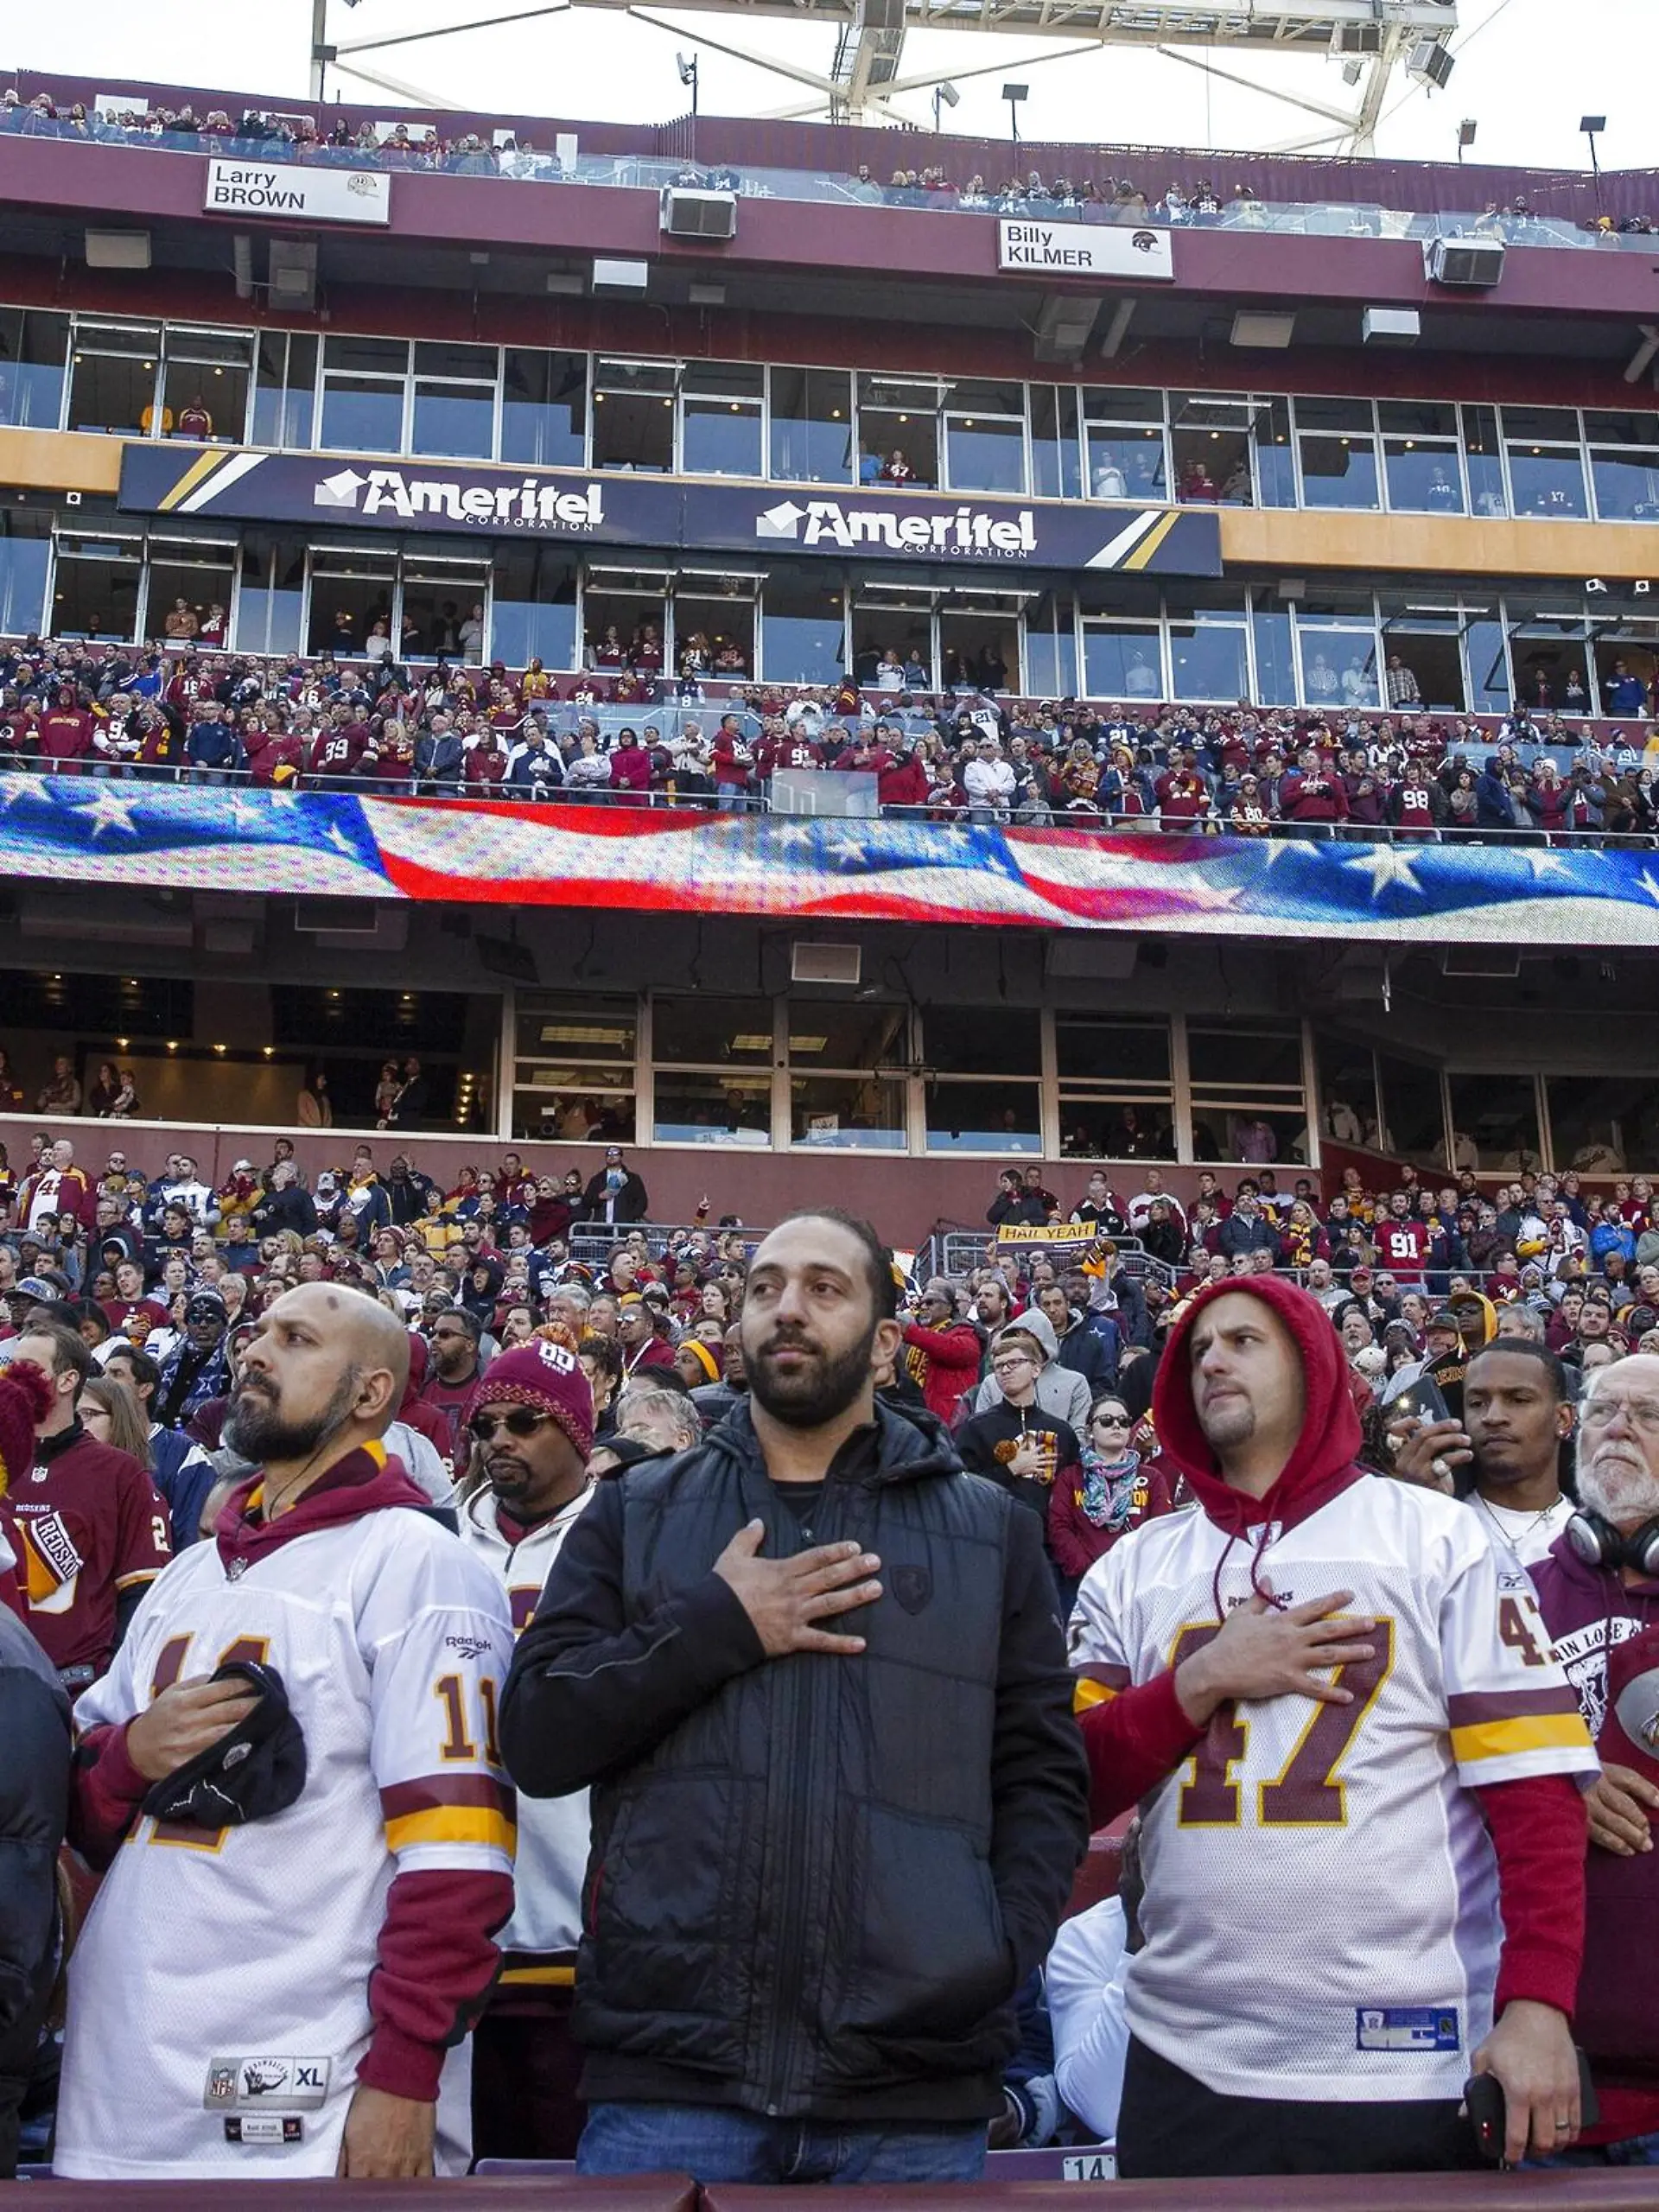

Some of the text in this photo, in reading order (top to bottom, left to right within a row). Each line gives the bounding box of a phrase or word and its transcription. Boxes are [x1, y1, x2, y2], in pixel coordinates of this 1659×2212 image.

[216, 165, 276, 188] Larry
[214, 187, 305, 209] BROWN
[1007, 226, 1052, 247] Billy
[1008, 245, 1093, 266] KILMER
[361, 469, 604, 524] Ameritel
[464, 514, 594, 532] CORPORATION
[803, 500, 1037, 550] Ameritel
[903, 543, 1028, 559] CORPORATION
[575, 692, 594, 706] 24
[681, 695, 691, 708] 8
[975, 711, 991, 724] 21
[1109, 728, 1129, 745] 21
[1403, 790, 1429, 810] 98
[1047, 1225, 1088, 1239] YEAH
[1390, 1233, 1418, 1259] 91
[1168, 1611, 1395, 1829] 47
[295, 2067, 324, 2087] XL
[1074, 2157, 1106, 2181] 14
